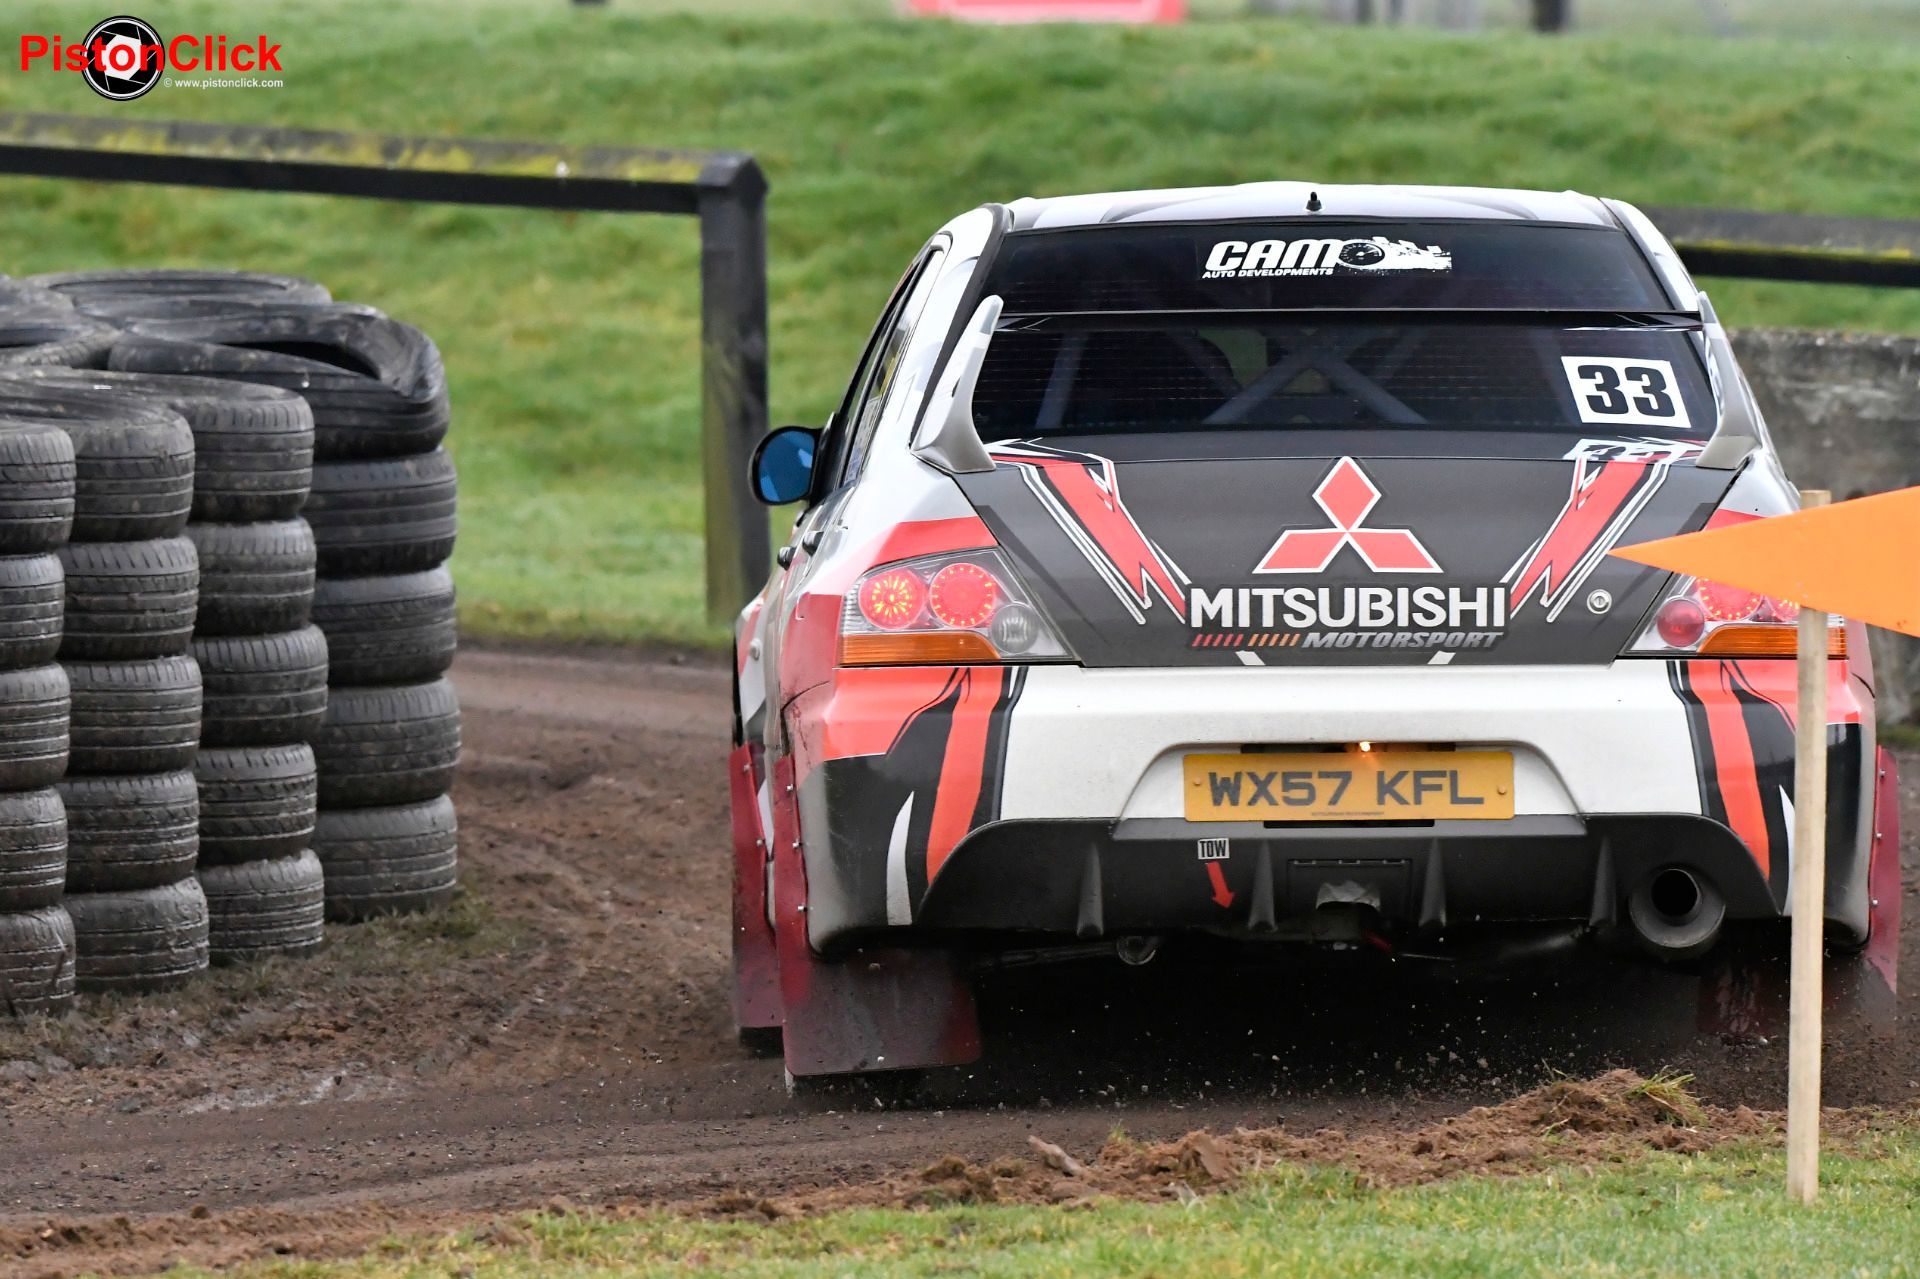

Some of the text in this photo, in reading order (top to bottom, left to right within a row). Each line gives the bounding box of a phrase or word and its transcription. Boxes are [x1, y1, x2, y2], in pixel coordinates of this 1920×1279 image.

[1202, 267, 1334, 279] AUTO DEVELOPMENTS
[1577, 364, 1676, 418] 33
[1190, 587, 1506, 628] MITSUBISHI
[1301, 631, 1504, 649] MOTORSPORT
[1208, 769, 1485, 807] WX57 KFL
[1200, 840, 1227, 858] TOW
